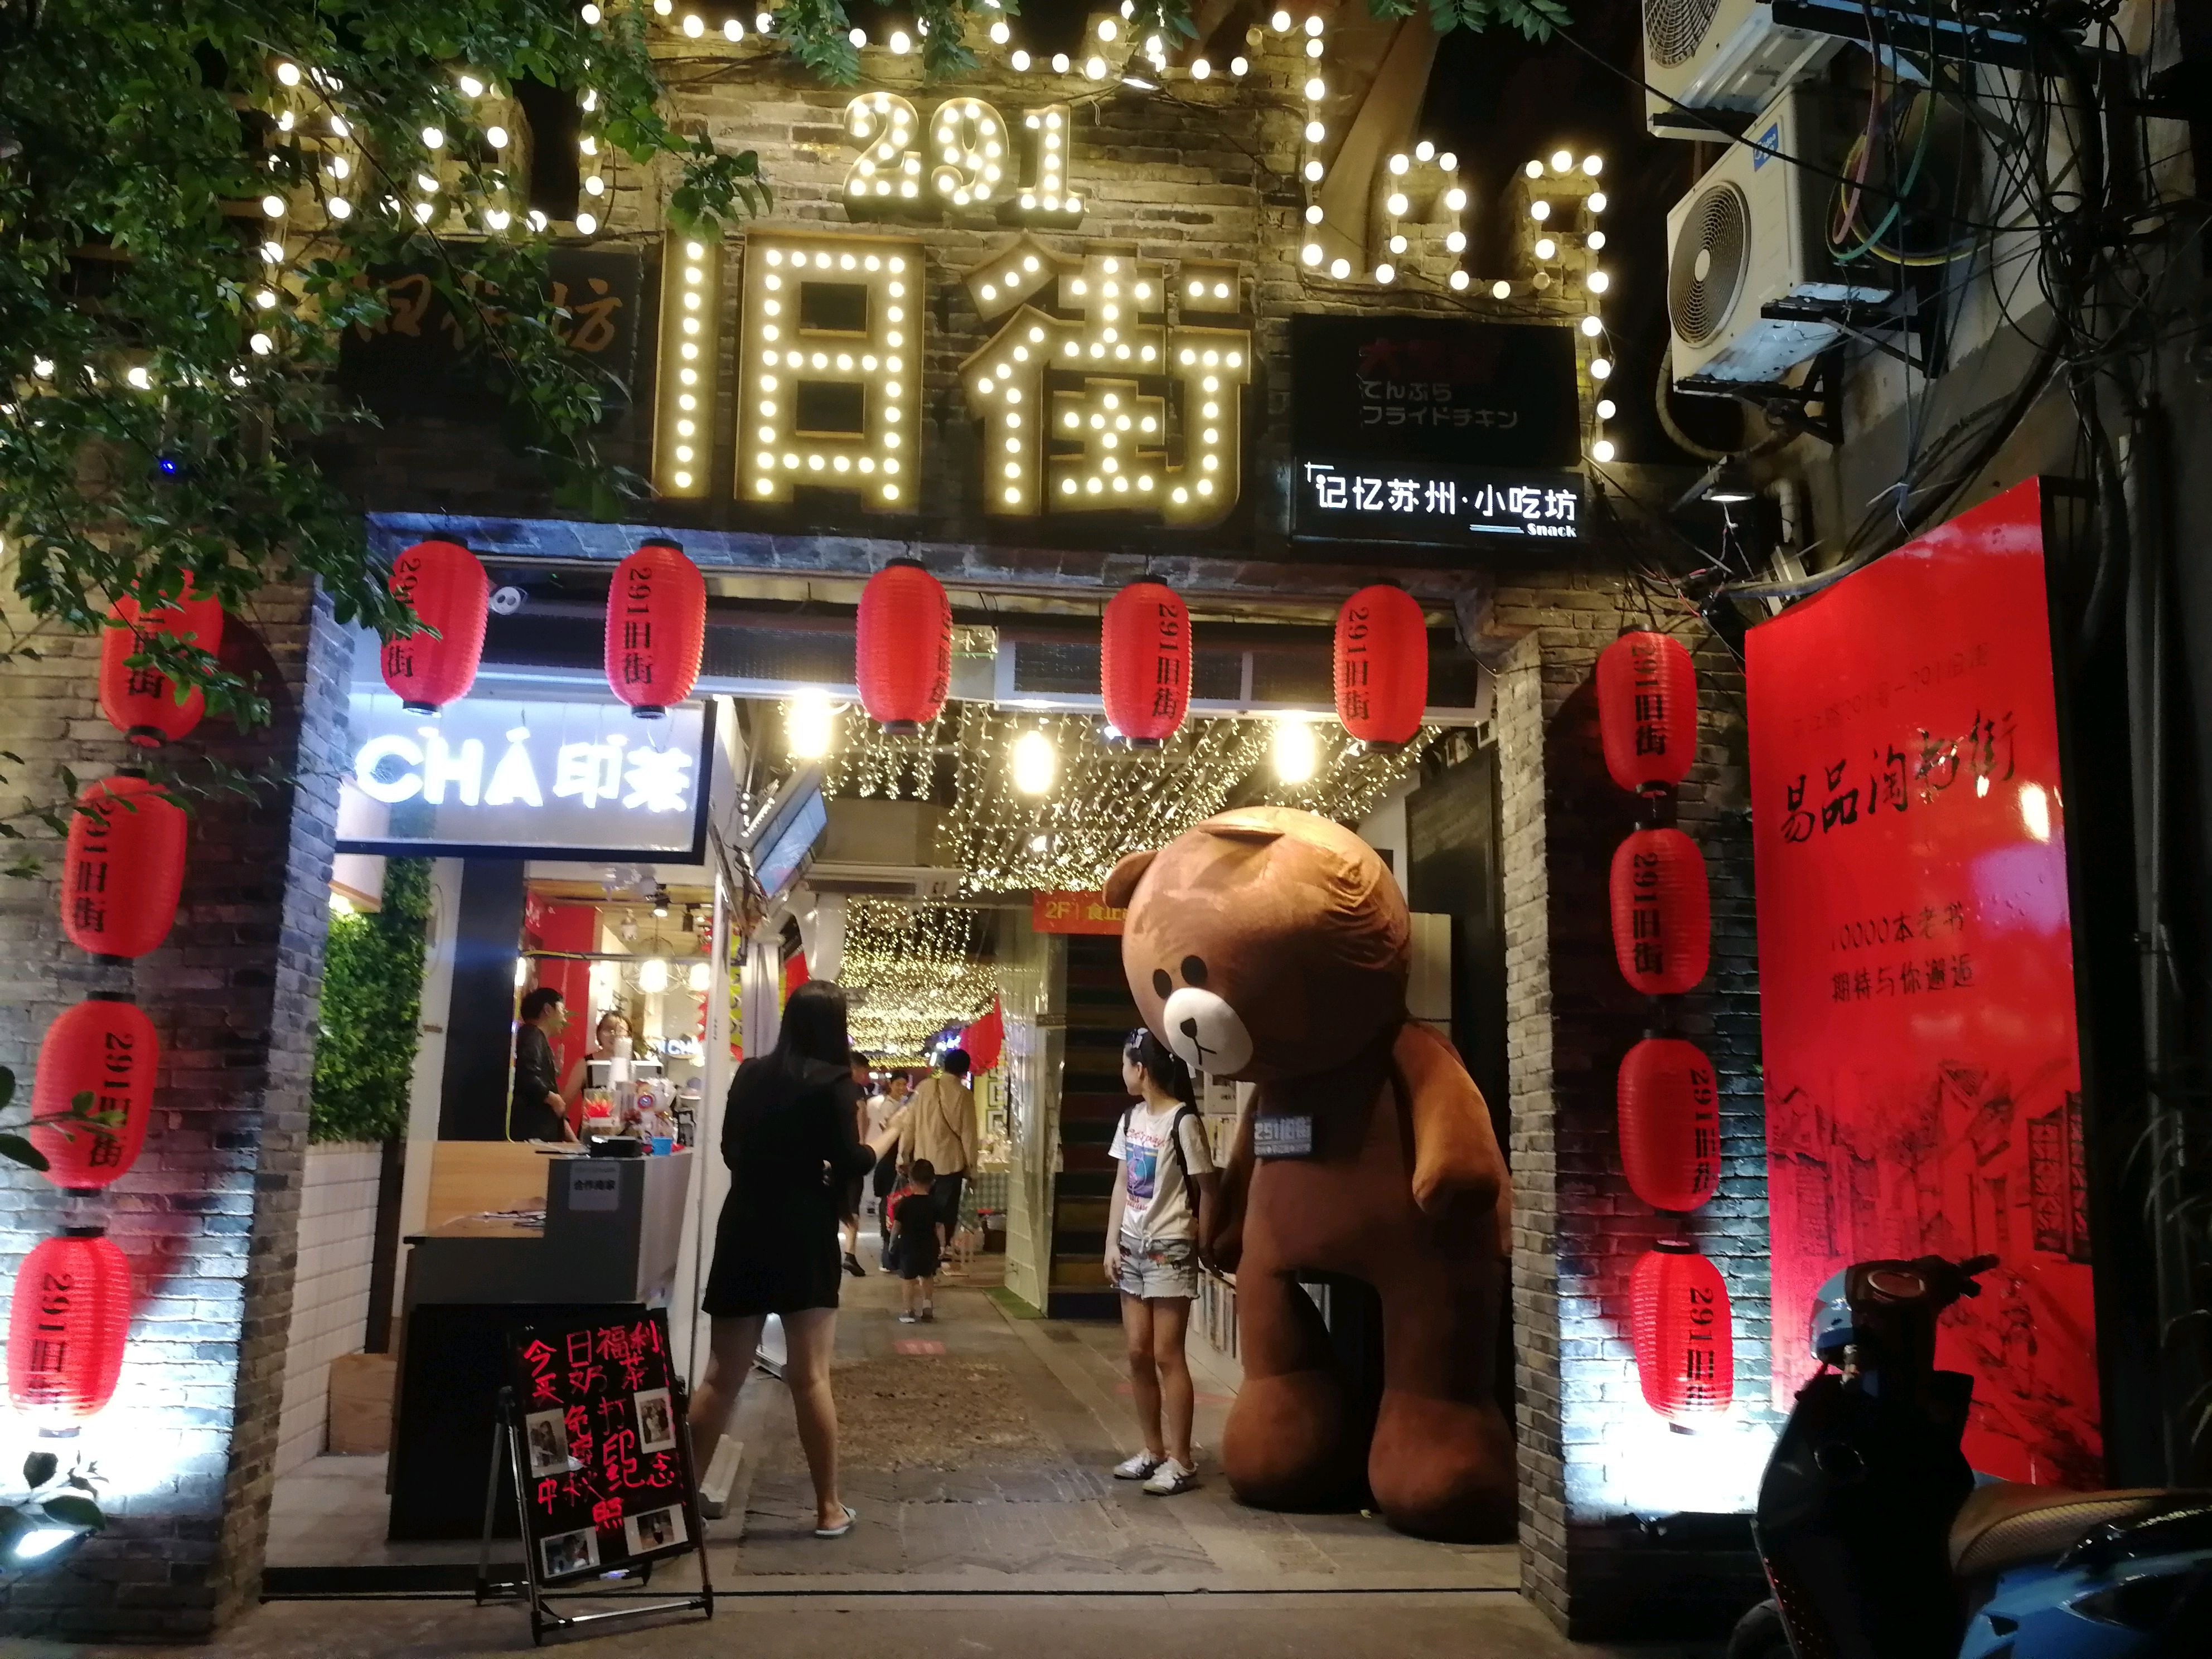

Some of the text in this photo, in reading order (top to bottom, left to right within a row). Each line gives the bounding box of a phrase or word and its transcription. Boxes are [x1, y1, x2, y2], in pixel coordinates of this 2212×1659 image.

[843, 91, 1086, 221] 291
[652, 226, 1251, 528] 旧街
[1527, 523, 1577, 538] Snack
[389, 557, 421, 678] 291街
[624, 567, 653, 685] 291旧街
[1153, 603, 1180, 719] 291旧街
[1343, 607, 1369, 721] 291旧街
[1632, 643, 1667, 756] 291旧街
[1044, 901, 1071, 919] 2F
[1633, 852, 1663, 974] 291旧街
[524, 1320, 659, 1377] 今日福利
